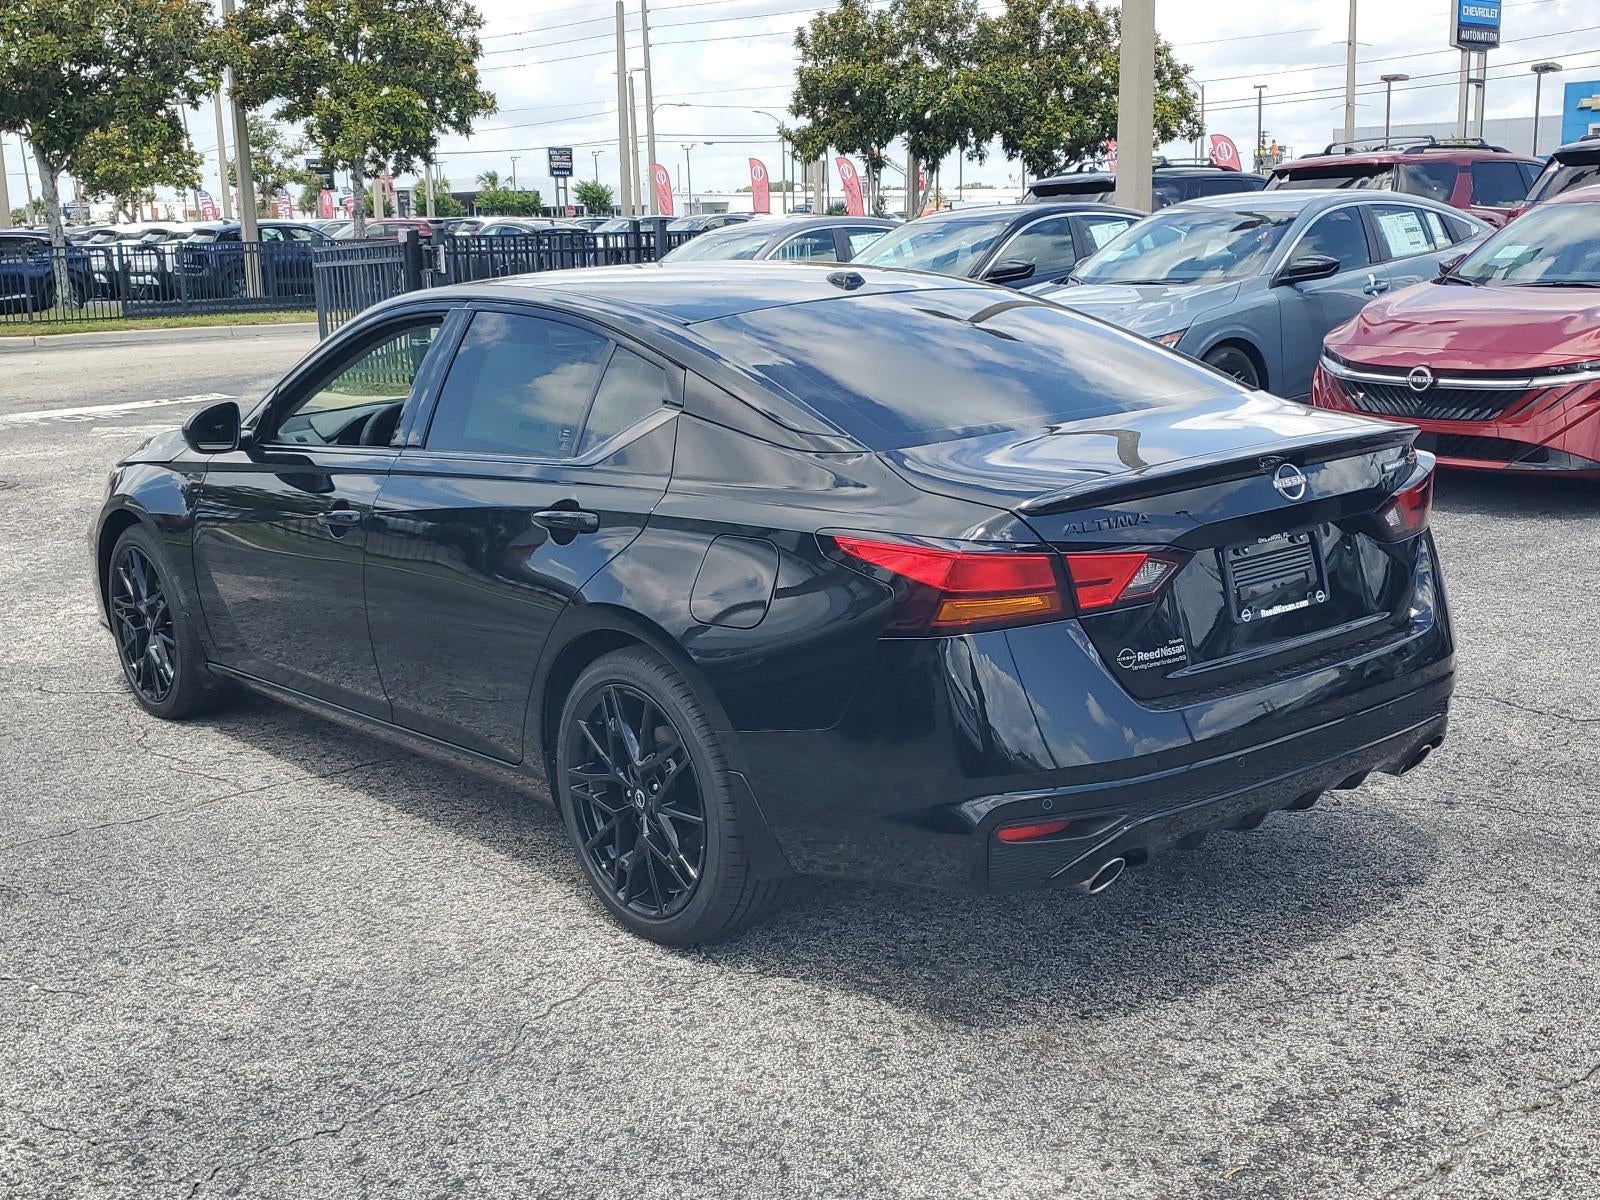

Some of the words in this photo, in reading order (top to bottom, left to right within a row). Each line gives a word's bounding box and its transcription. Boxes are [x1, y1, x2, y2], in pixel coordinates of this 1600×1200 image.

[1462, 5, 1498, 19] CHEVROLET
[1461, 28, 1498, 42] AUTONATION
[1273, 474, 1307, 489] NISSAN
[1064, 512, 1151, 536] ALTIMA
[1261, 600, 1309, 618] ReedNissan.com
[1116, 654, 1137, 662] NISSAN
